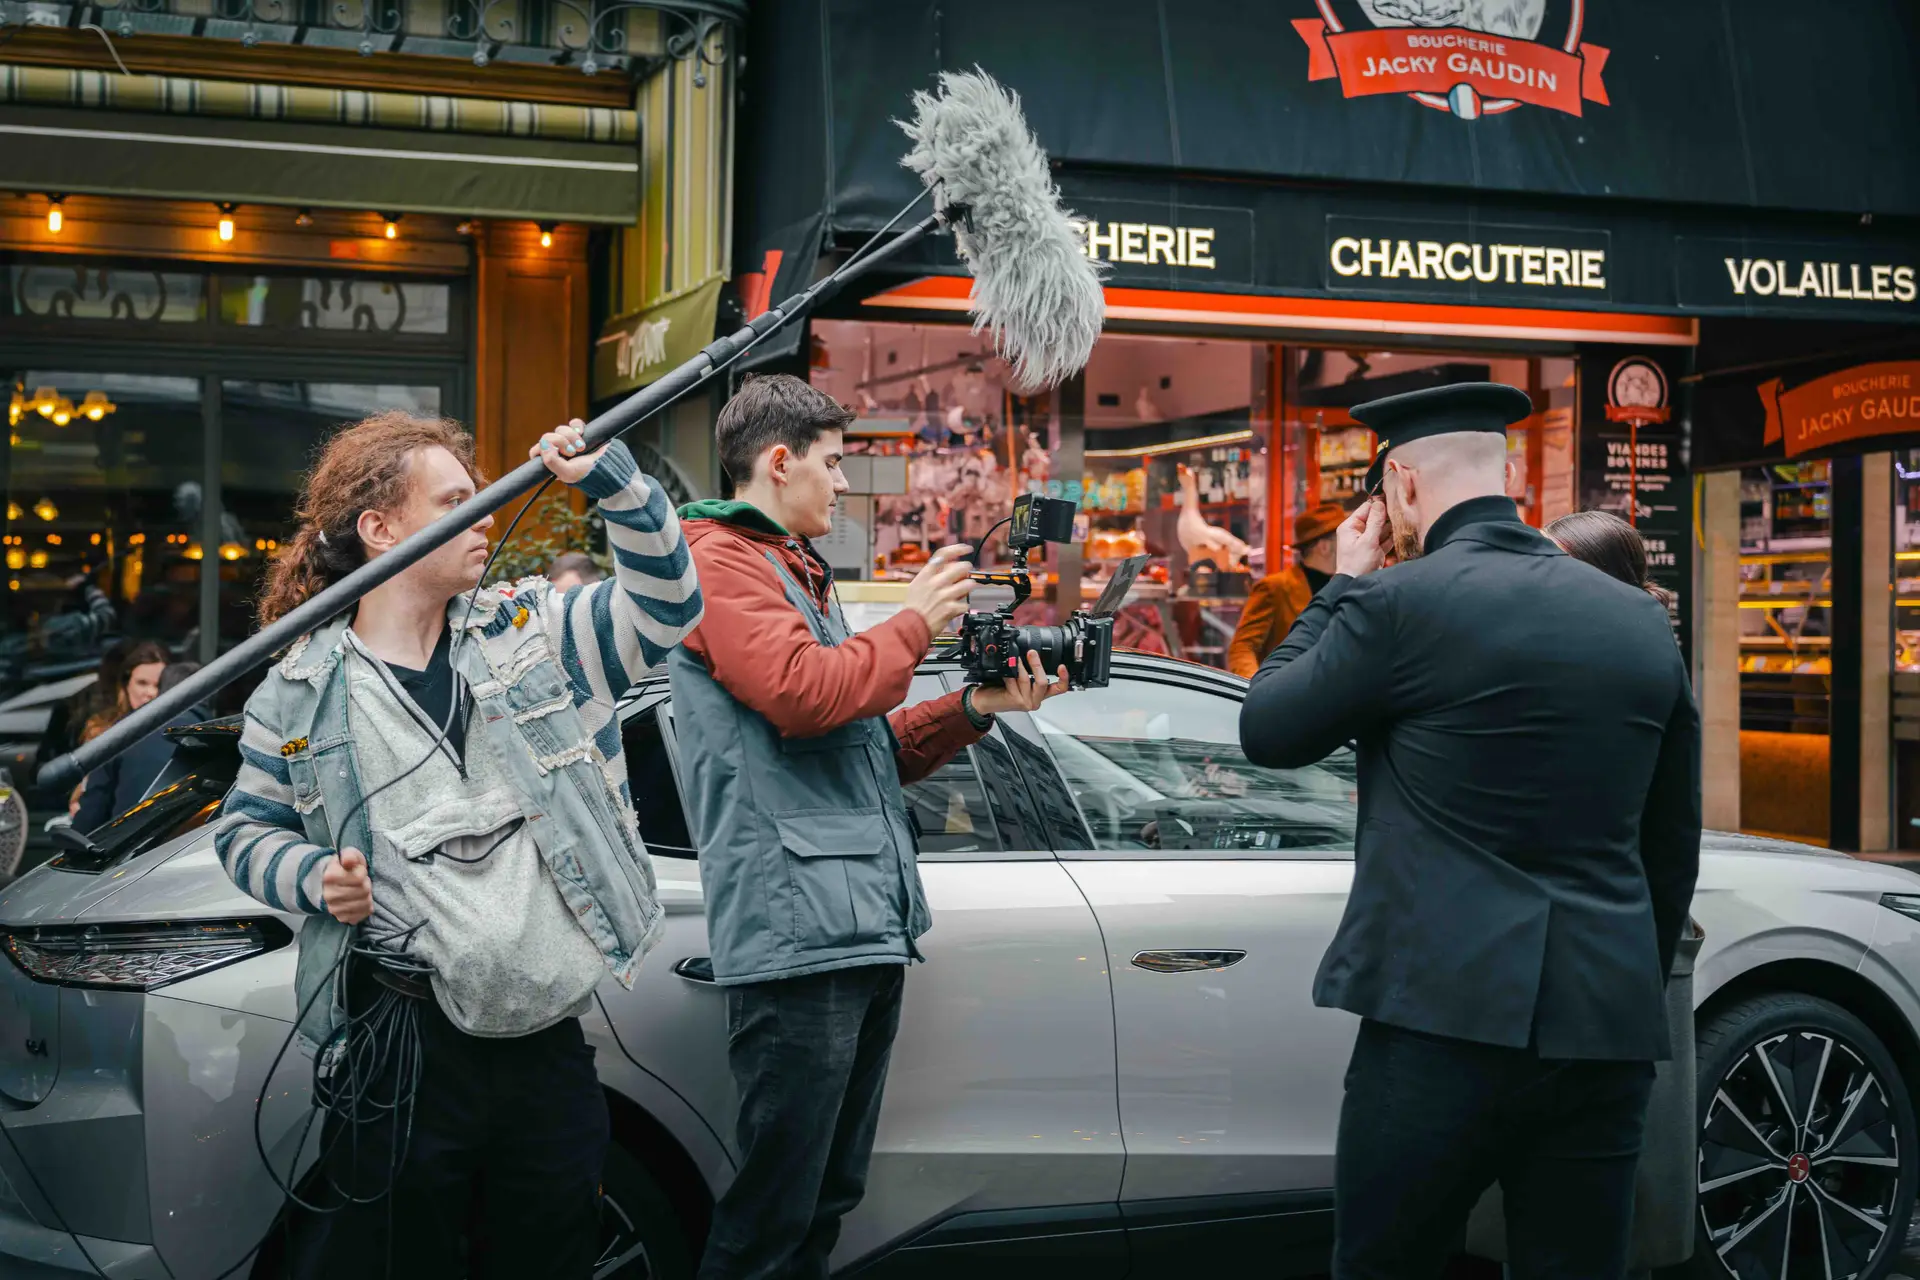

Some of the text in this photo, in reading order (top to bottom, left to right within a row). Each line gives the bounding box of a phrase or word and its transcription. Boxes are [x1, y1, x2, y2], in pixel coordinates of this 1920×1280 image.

[1407, 34, 1507, 56] BOUCHERIE
[1362, 53, 1558, 92] JACKY GAUDIN
[1330, 236, 1606, 289] CHARCUTERIE
[1725, 258, 1917, 302] VOLAILLES
[1832, 375, 1911, 399] BOUCHERIE
[1797, 405, 1854, 440] JACKY
